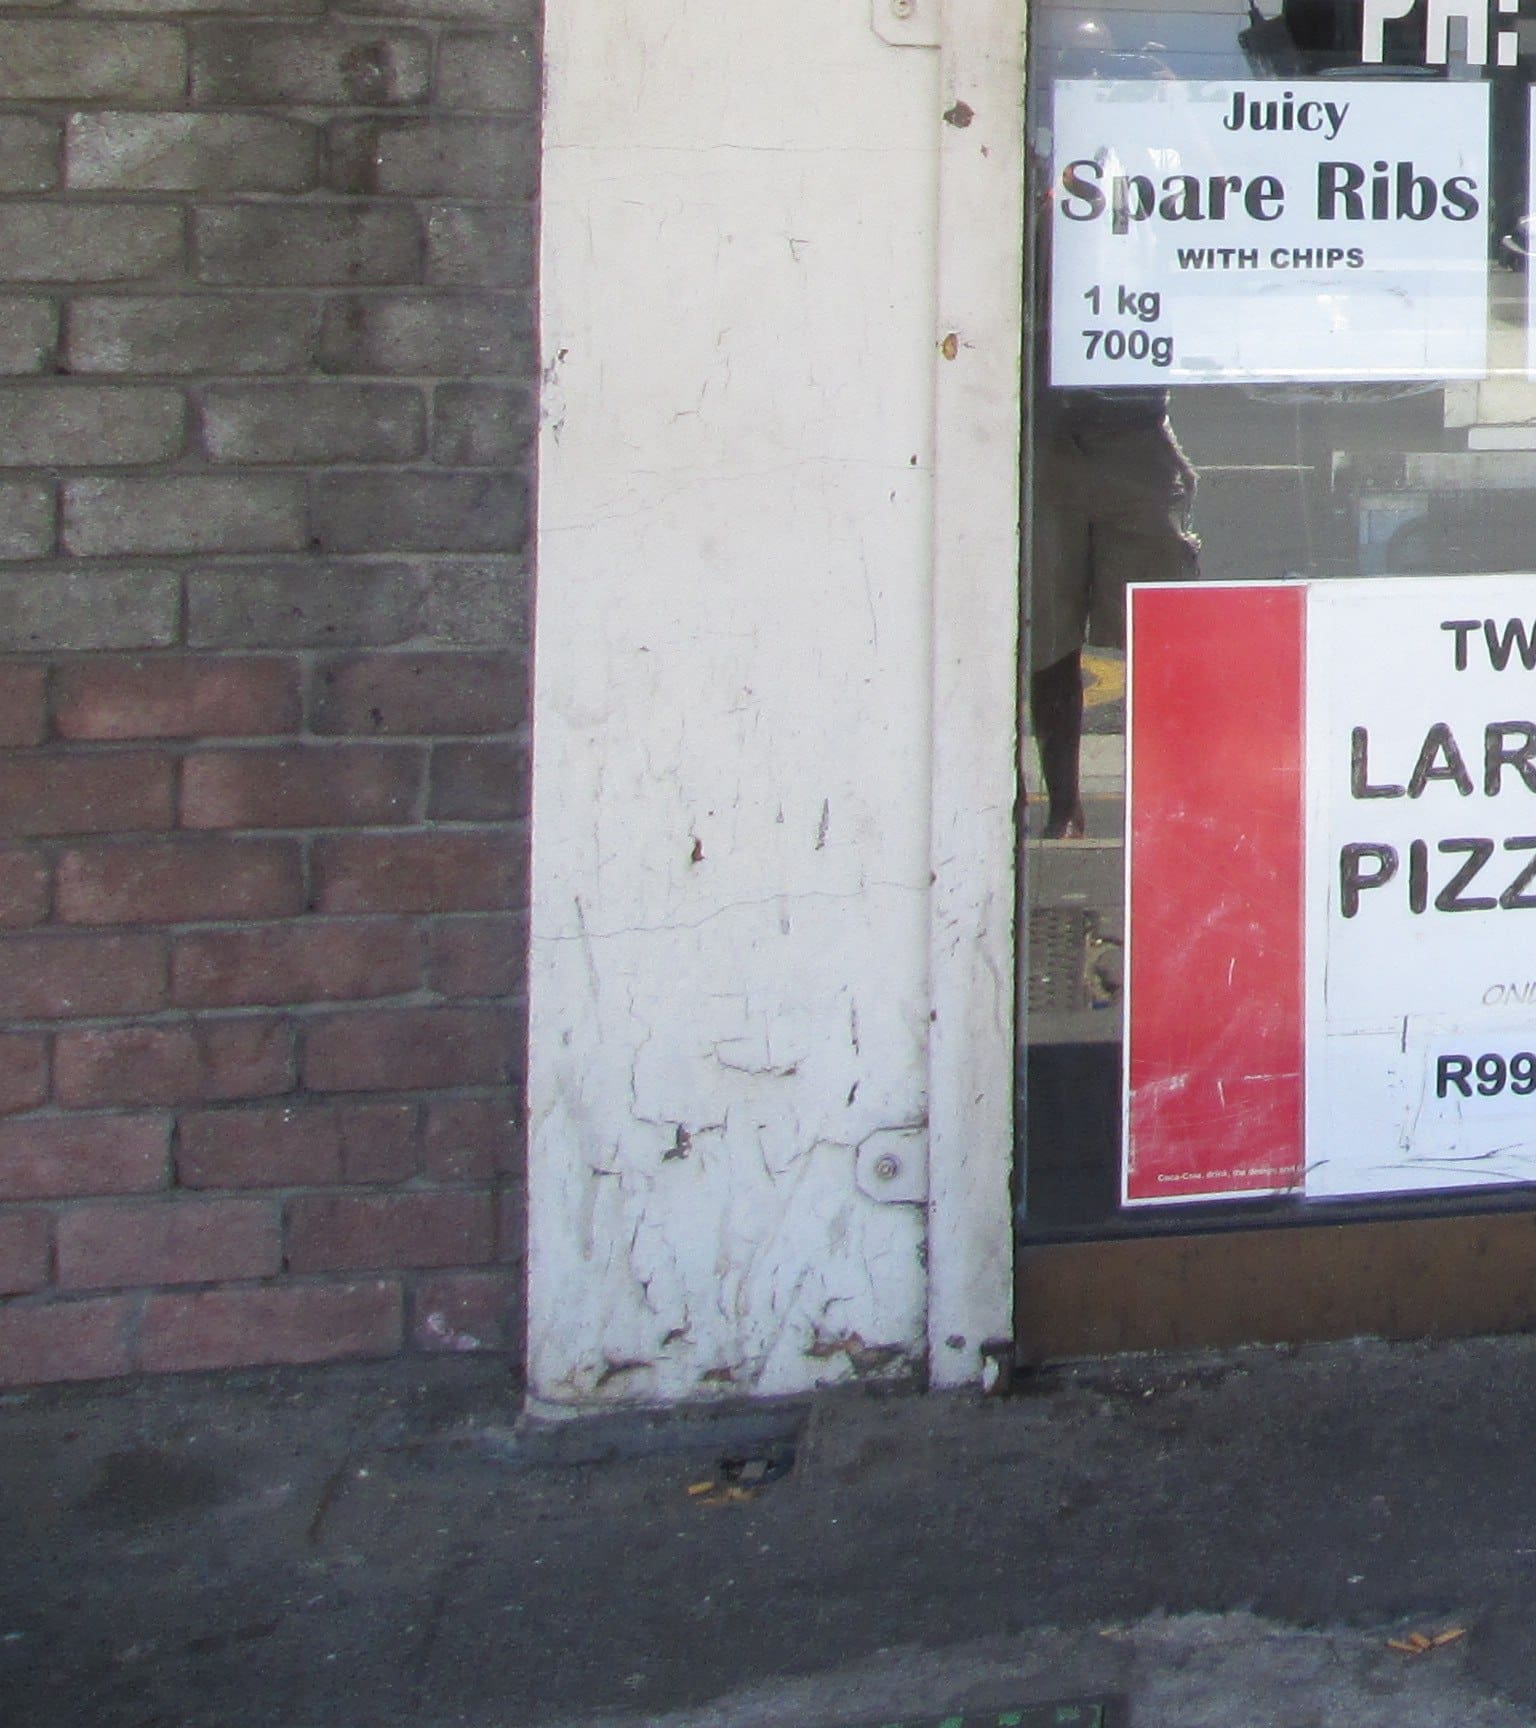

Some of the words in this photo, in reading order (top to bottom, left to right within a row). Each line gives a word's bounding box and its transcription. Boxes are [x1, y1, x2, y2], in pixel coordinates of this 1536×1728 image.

[1222, 90, 1351, 142] Juicy
[1060, 159, 1286, 235] Spare
[1316, 160, 1481, 222] Ribs
[1177, 247, 1259, 270] WITH
[1269, 247, 1366, 270] CHIPS
[1083, 285, 1101, 316] 1
[1117, 285, 1161, 323] kg
[1081, 329, 1175, 368] 700g
